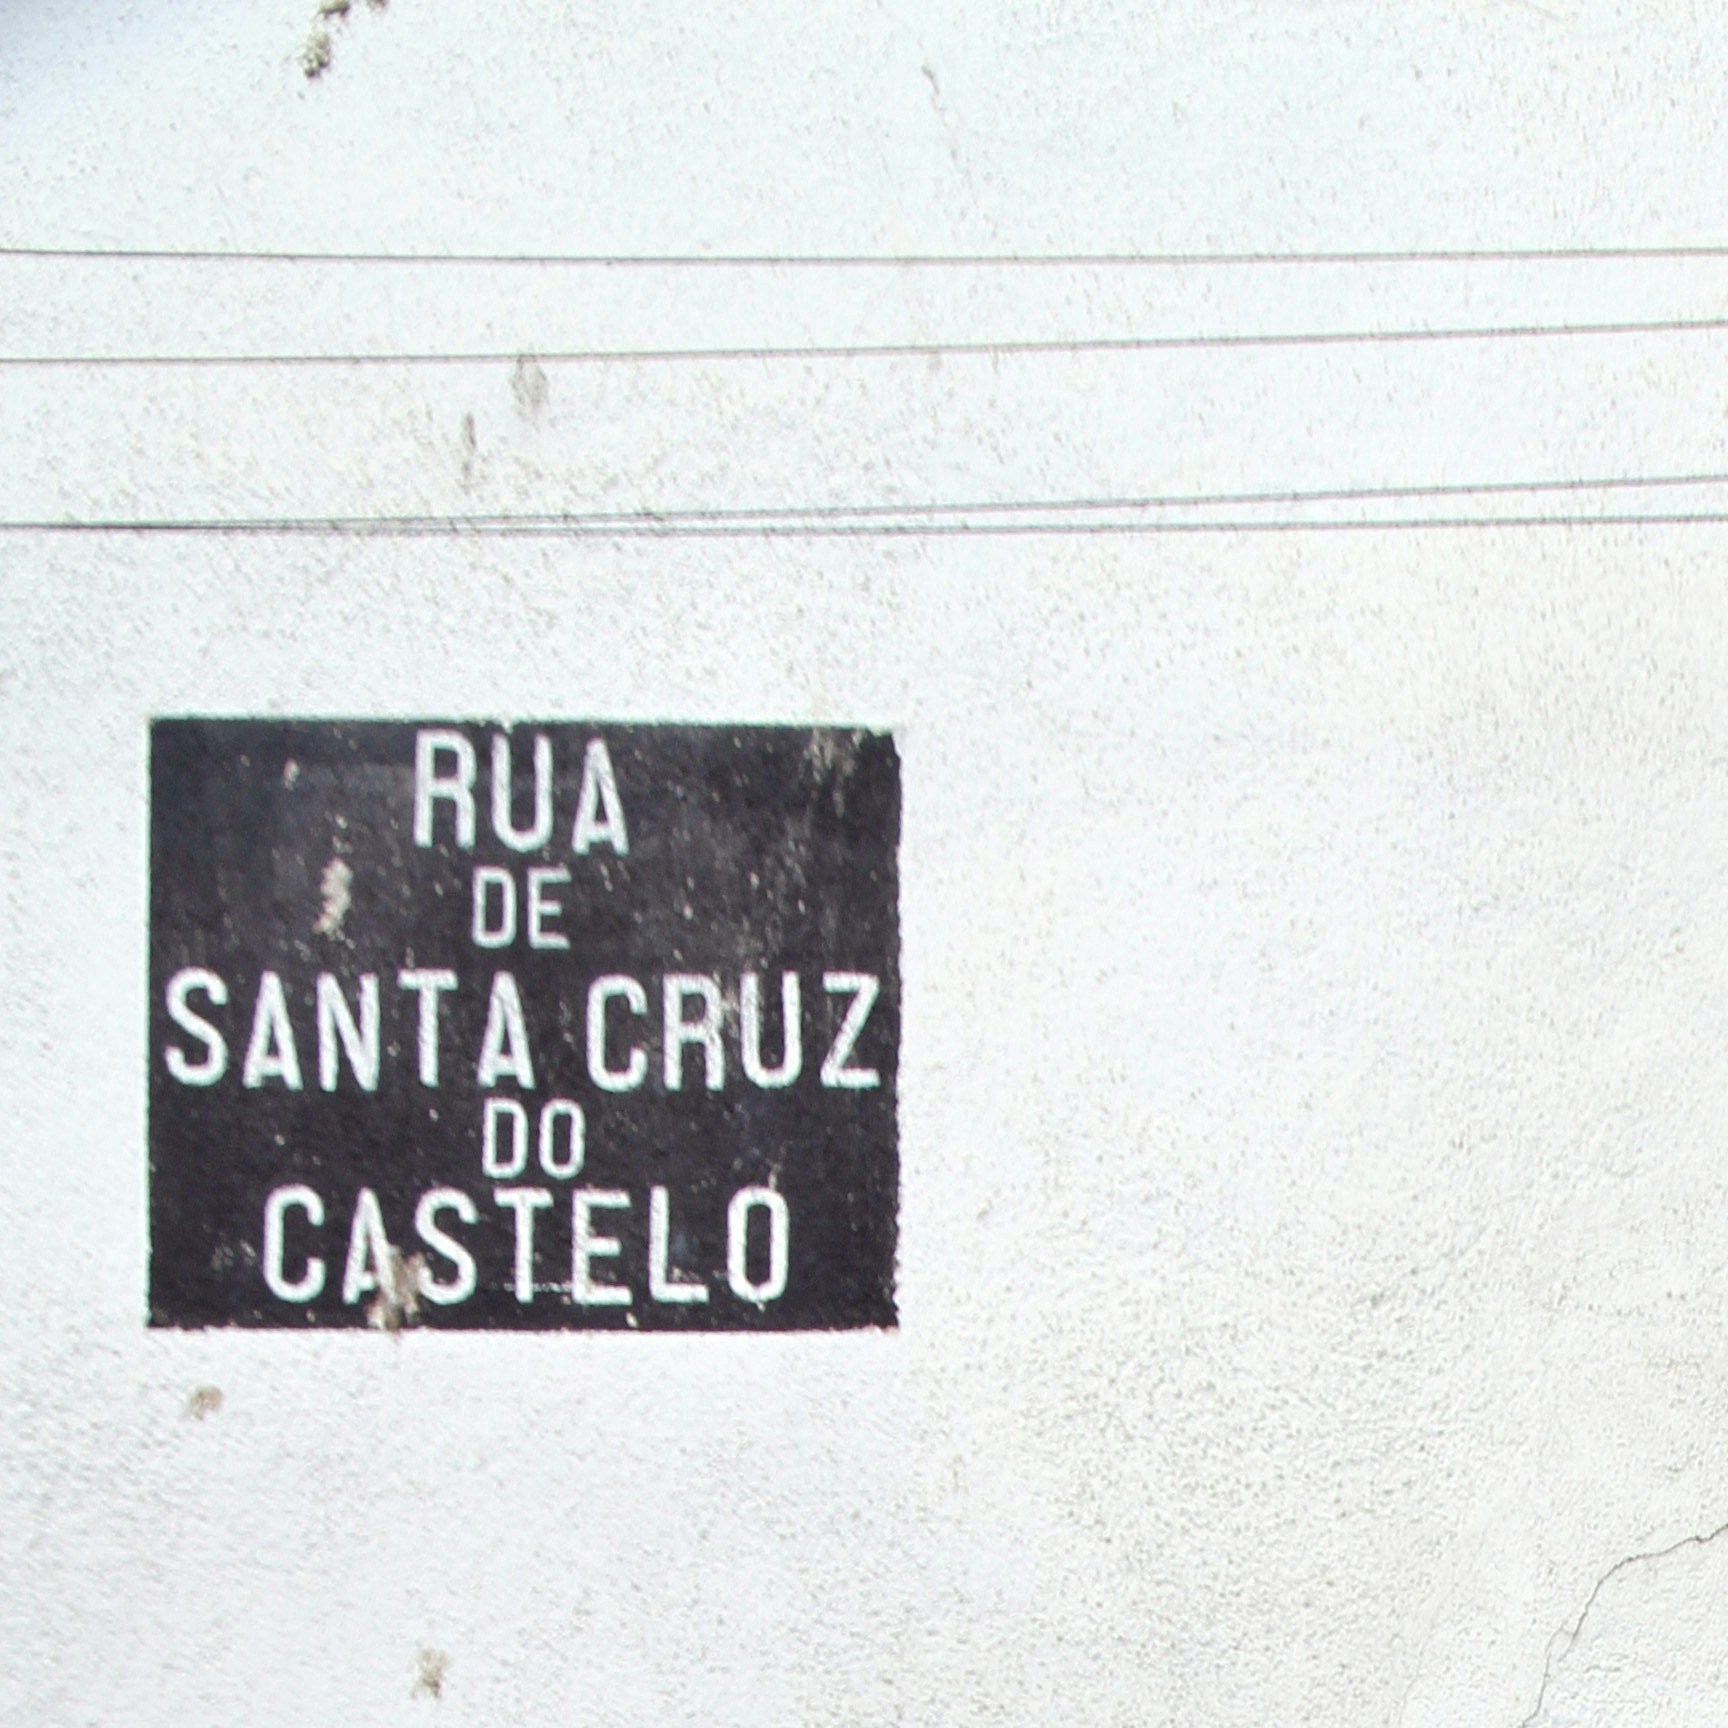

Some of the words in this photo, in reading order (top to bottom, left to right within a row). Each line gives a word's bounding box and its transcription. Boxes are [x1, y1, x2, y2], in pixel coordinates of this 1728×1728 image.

[412, 728, 630, 856] RUA
[470, 865, 572, 949] DE
[163, 966, 536, 1093] SANTA
[585, 970, 881, 1093] CRUZ
[480, 1096, 586, 1180] DO
[261, 1183, 790, 1307] CASTELO
